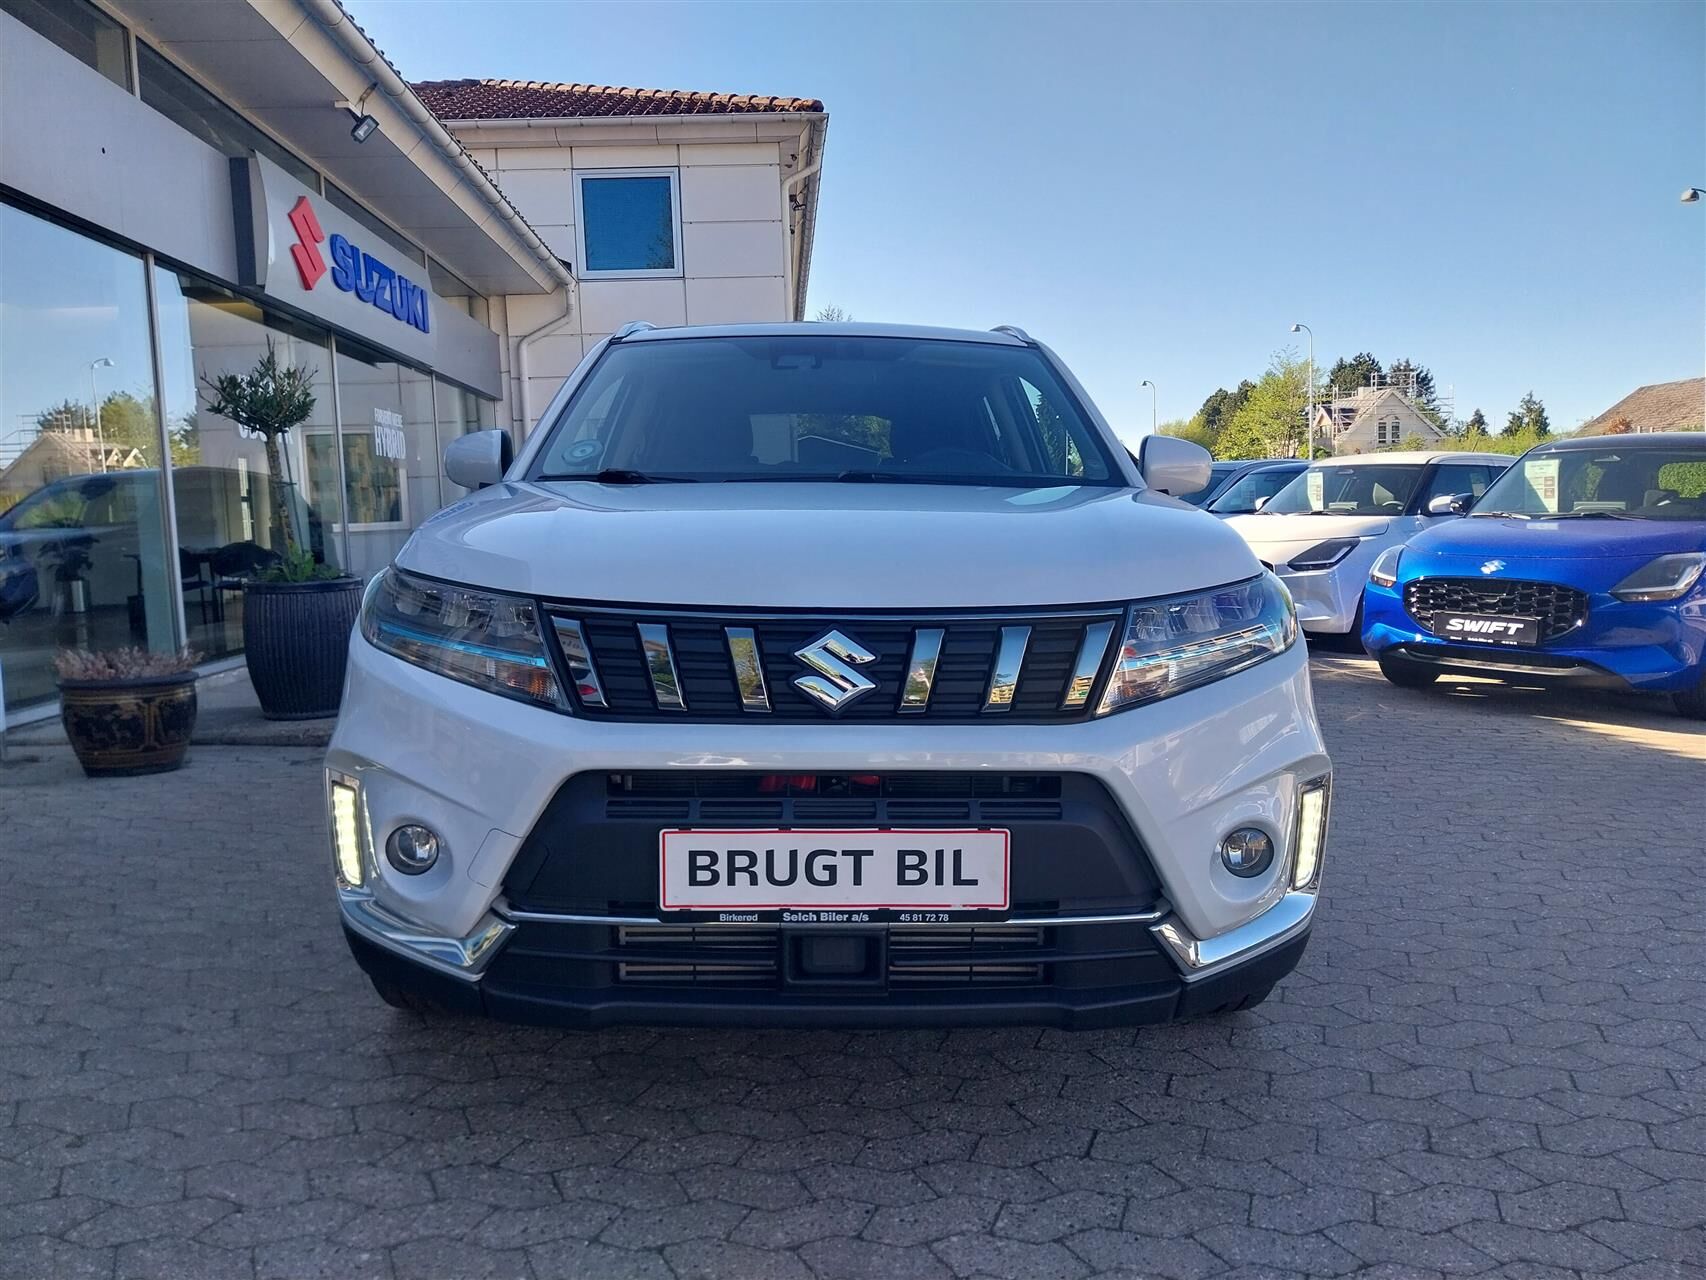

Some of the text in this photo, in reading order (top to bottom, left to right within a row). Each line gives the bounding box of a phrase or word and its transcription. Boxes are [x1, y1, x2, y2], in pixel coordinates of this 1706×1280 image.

[330, 233, 430, 334] SUZUKI
[374, 425, 406, 459] HYBRID
[1445, 618, 1524, 635] SWIFT
[688, 849, 979, 887] BRUGT BIL
[782, 912, 869, 922] Selch Biler a/s
[899, 913, 949, 922] 45 81 72 78
